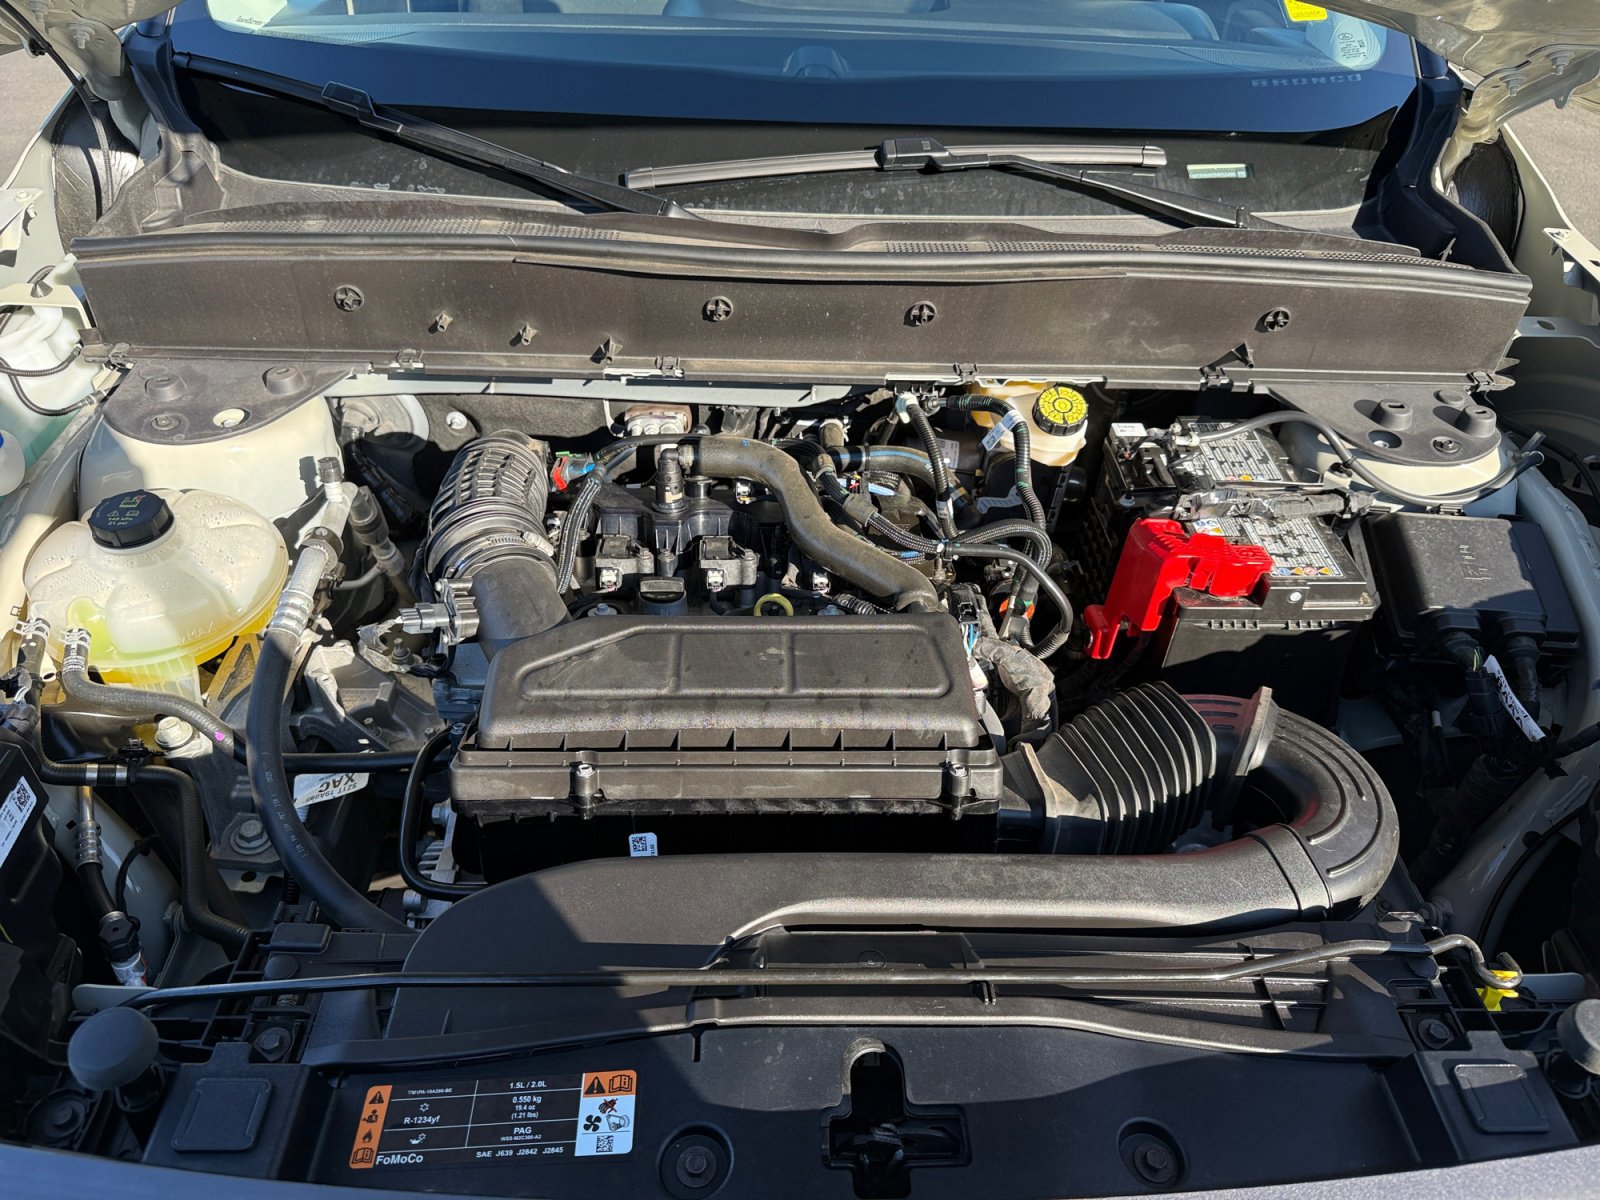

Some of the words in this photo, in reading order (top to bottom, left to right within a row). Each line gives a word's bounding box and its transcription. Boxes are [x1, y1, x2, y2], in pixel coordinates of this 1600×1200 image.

[1251, 73, 1362, 87] BRONCO
[319, 773, 355, 792] XAC
[531, 1080, 547, 1088] 2.0L
[512, 1095, 532, 1104] 0.550
[532, 1095, 542, 1104] kg
[403, 1115, 440, 1125] R-1234yf
[511, 1112, 526, 1120] (1.21
[527, 1111, 539, 1119] lbs)
[513, 1126, 532, 1135] PAG
[475, 1150, 492, 1158] SAE
[495, 1149, 513, 1157] J639
[516, 1148, 538, 1156] J2842
[542, 1146, 564, 1154] J2845
[376, 1153, 424, 1165] FoMoCo
